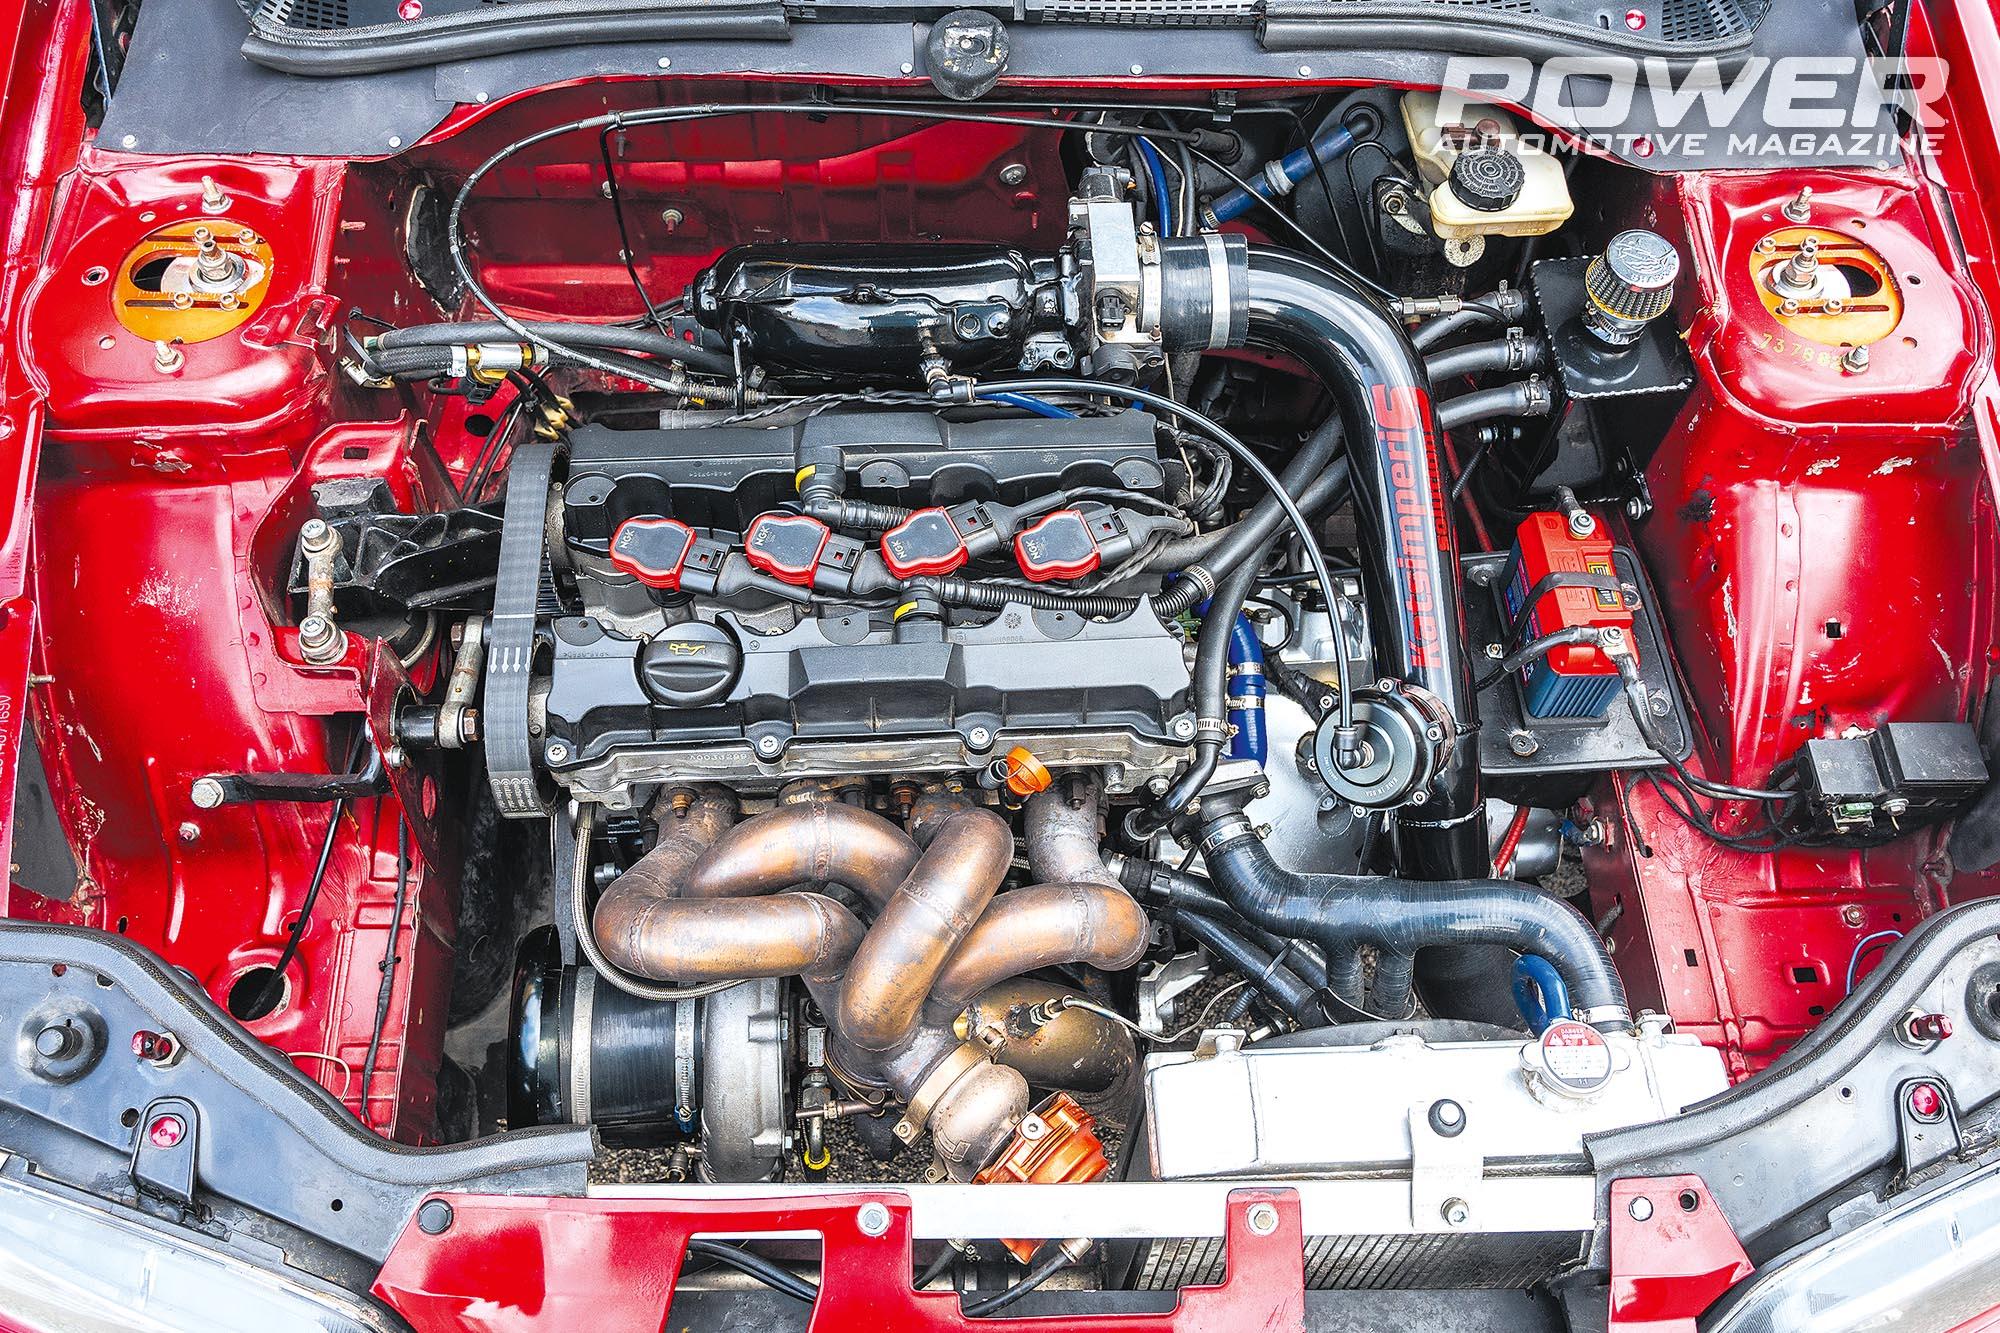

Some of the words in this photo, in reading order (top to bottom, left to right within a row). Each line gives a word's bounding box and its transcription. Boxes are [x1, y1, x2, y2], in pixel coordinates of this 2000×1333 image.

[620, 529, 635, 549] NGK
[755, 526, 770, 546] NGK
[891, 539, 907, 558] NGK
[1026, 539, 1041, 559] NGK
